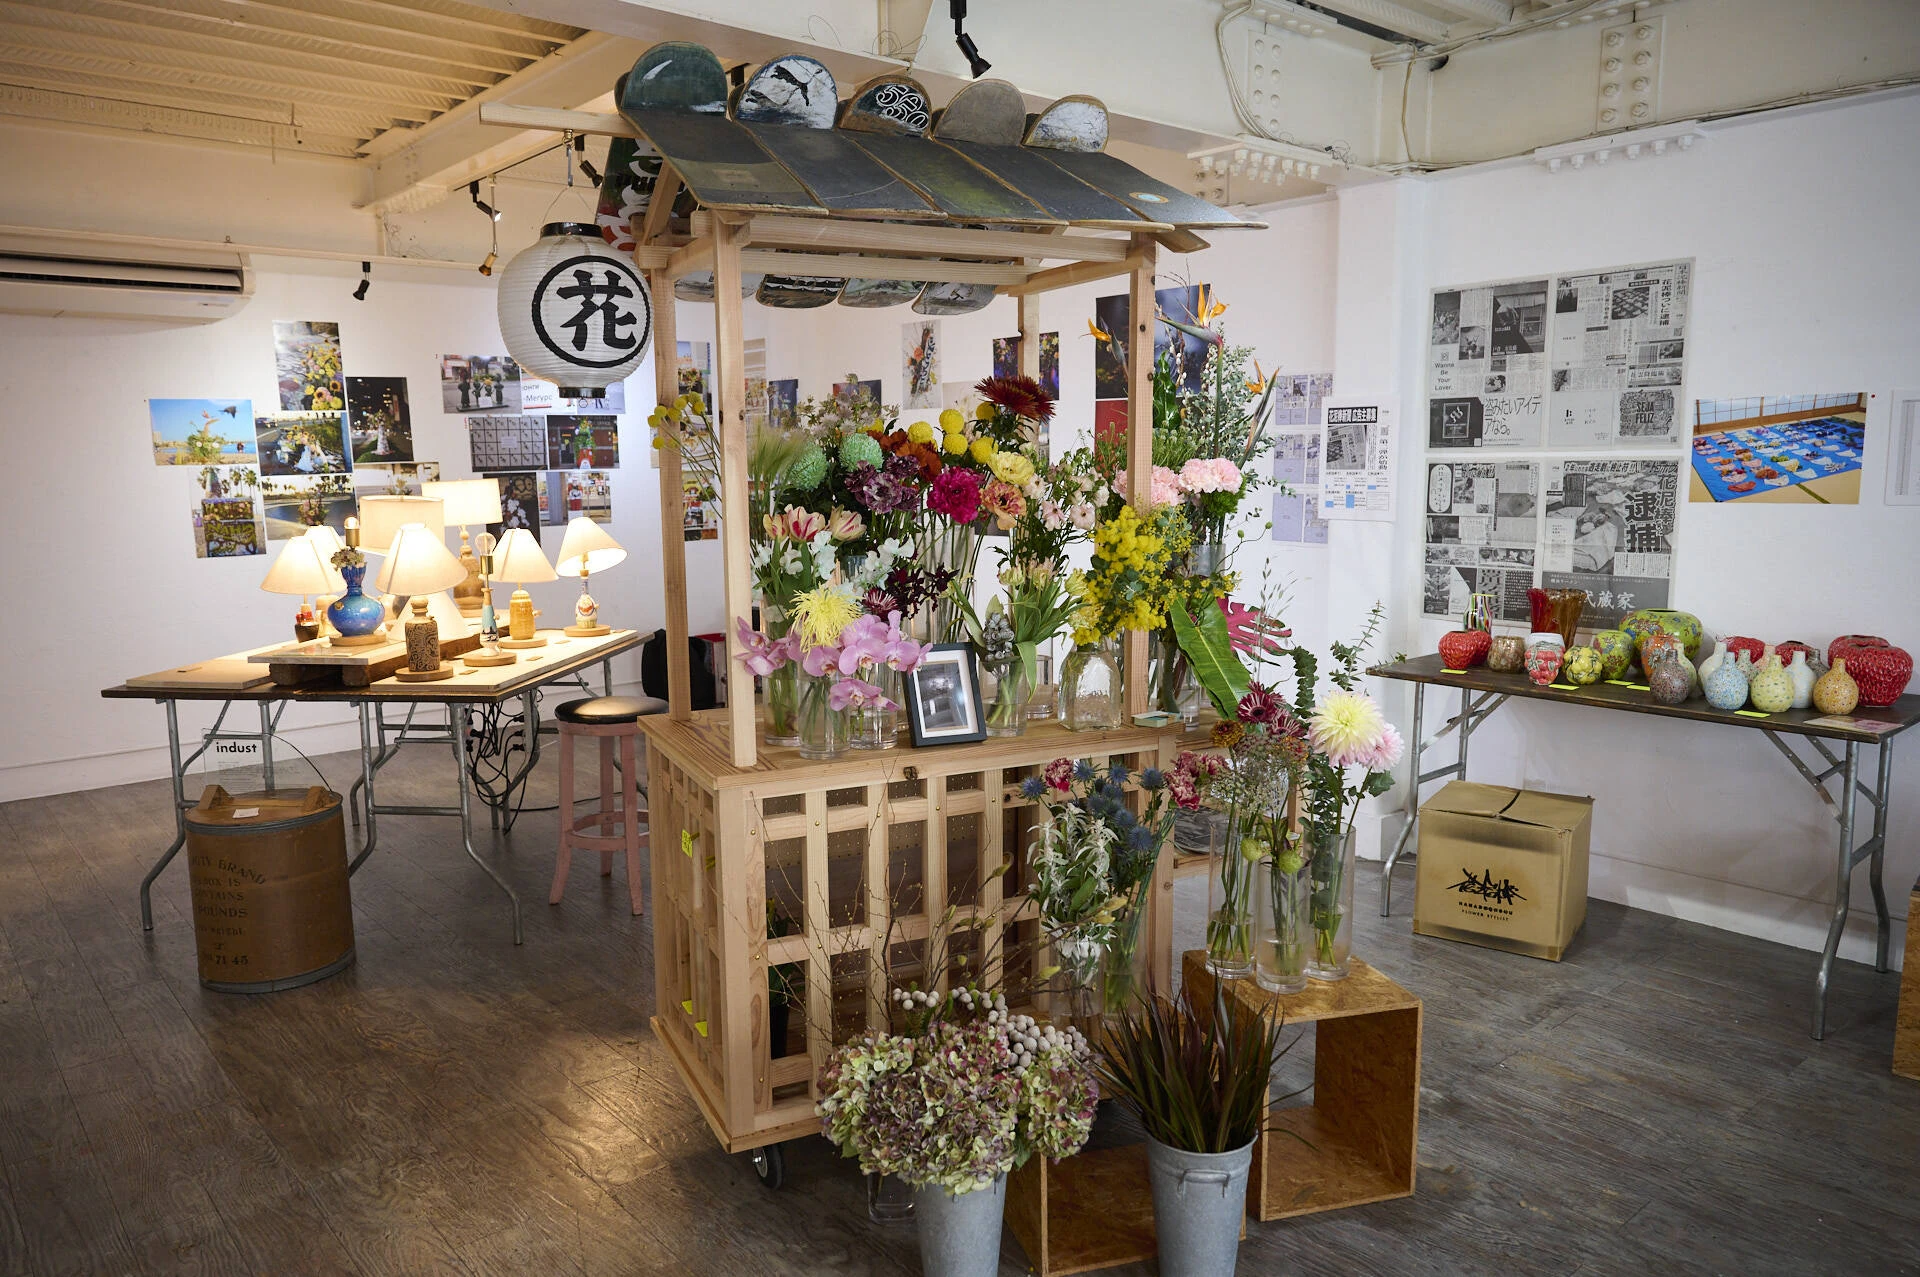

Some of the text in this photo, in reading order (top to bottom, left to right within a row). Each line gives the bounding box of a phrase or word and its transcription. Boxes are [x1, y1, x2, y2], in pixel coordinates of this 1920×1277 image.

[557, 268, 638, 352] 花
[1636, 401, 1655, 413] SEJA
[1635, 412, 1655, 424] FELIZ
[216, 742, 257, 753] indust
